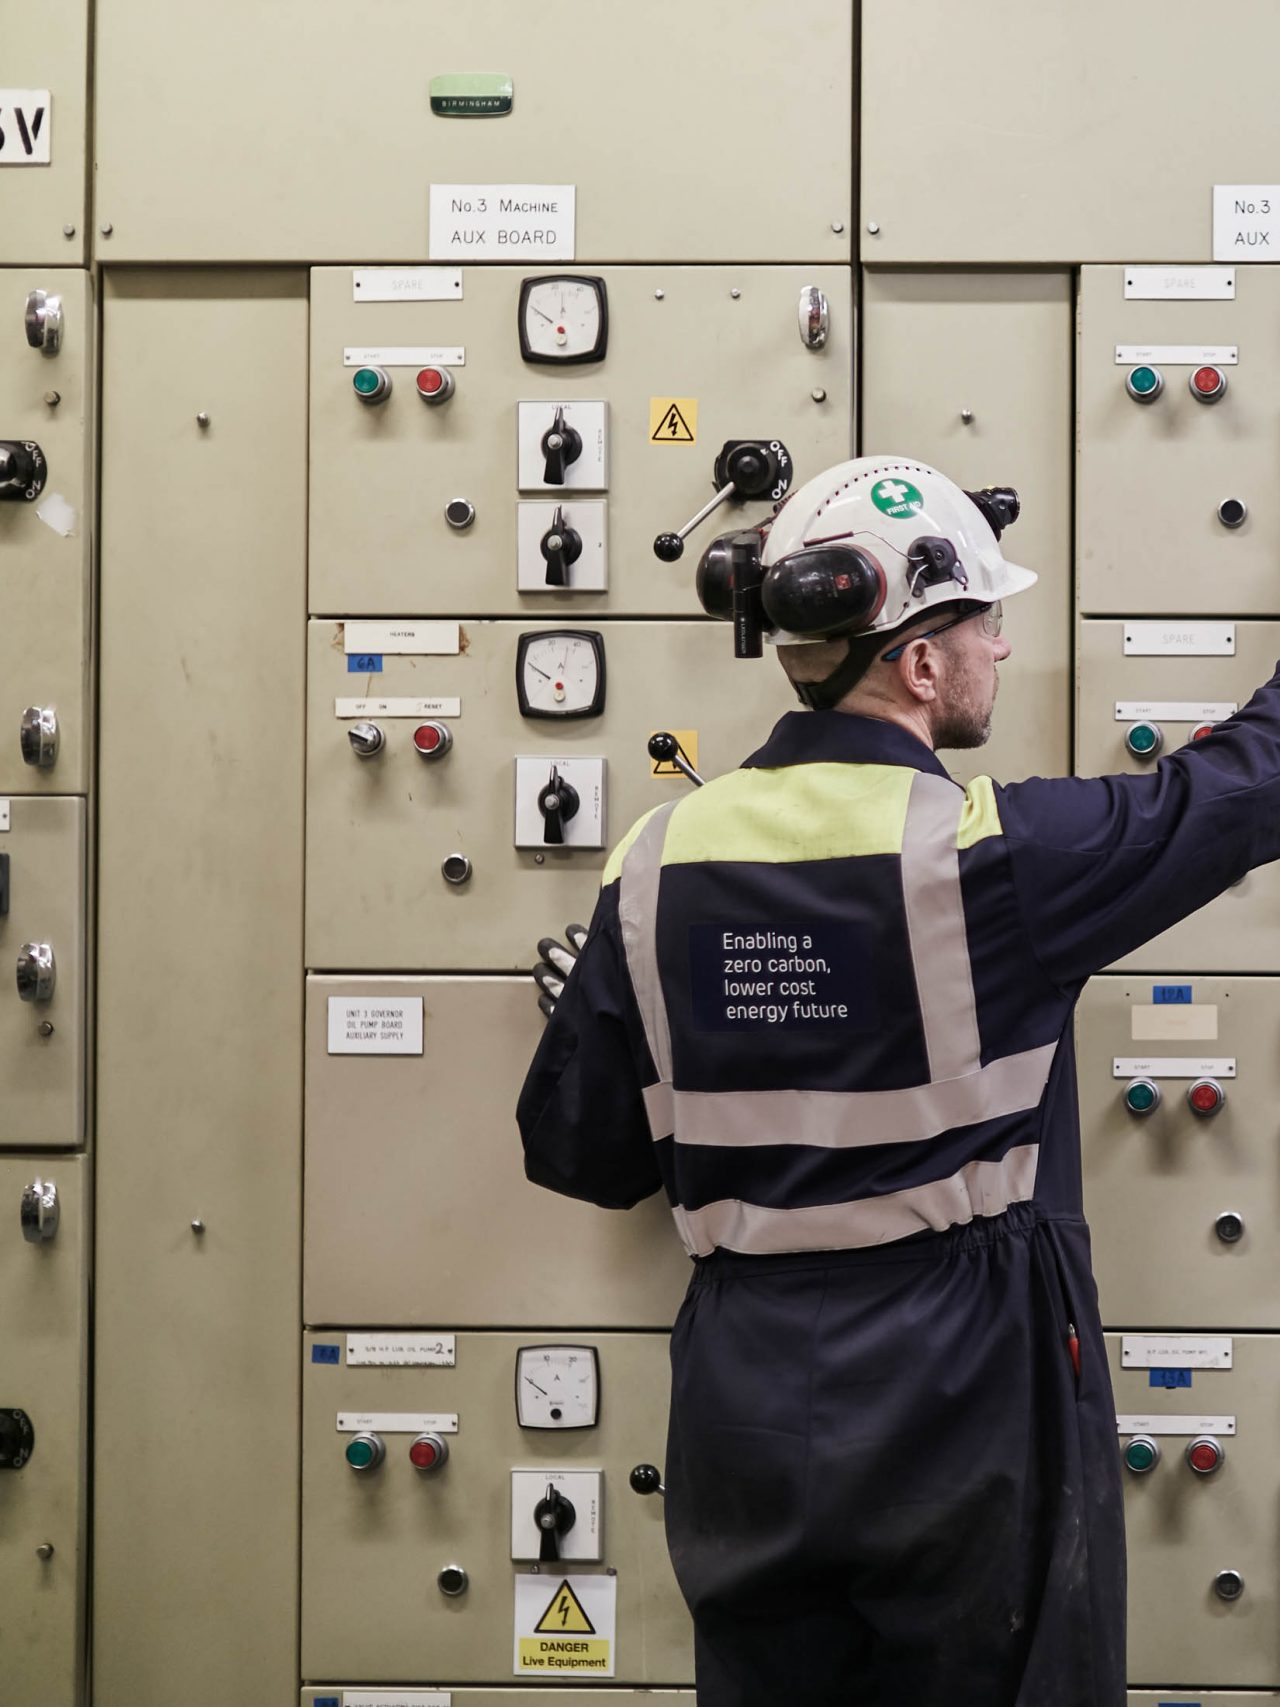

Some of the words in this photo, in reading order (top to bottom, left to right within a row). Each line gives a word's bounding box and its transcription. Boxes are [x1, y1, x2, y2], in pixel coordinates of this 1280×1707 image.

[441, 100, 501, 108] BIRMINGHAM
[0, 107, 45, 155] V
[451, 198, 488, 213] No.3
[1234, 199, 1271, 214] No.3
[451, 230, 486, 244] AUX
[497, 230, 557, 244] BOARD
[1234, 231, 1270, 245] AUX
[391, 279, 423, 290] SPARE
[1163, 278, 1196, 288] SPARE
[770, 441, 788, 467] OFF
[25, 480, 41, 498] ON
[771, 479, 788, 499] ON
[886, 503, 909, 515] FIRST
[1162, 633, 1195, 645] SPARE
[722, 932, 798, 953] Enabling
[802, 935, 812, 949] a
[724, 959, 762, 973] zero
[768, 955, 831, 974] carbon,
[724, 979, 775, 996] lower
[779, 980, 817, 996] cost
[346, 1010, 360, 1018] UNIT
[364, 1010, 368, 1018] 3
[371, 1010, 403, 1018] GOVERNOR
[726, 1004, 789, 1023] energy
[792, 1001, 848, 1019] future
[346, 1021, 356, 1029] OIL
[360, 1021, 378, 1029] PUMP
[381, 1021, 403, 1029] BOARD
[346, 1031, 377, 1040] AUXILIARY
[380, 1031, 403, 1040] SUPPLY
[539, 1641, 589, 1653] DANGER
[522, 1656, 545, 1667] Live
[547, 1657, 606, 1670] Equipment
